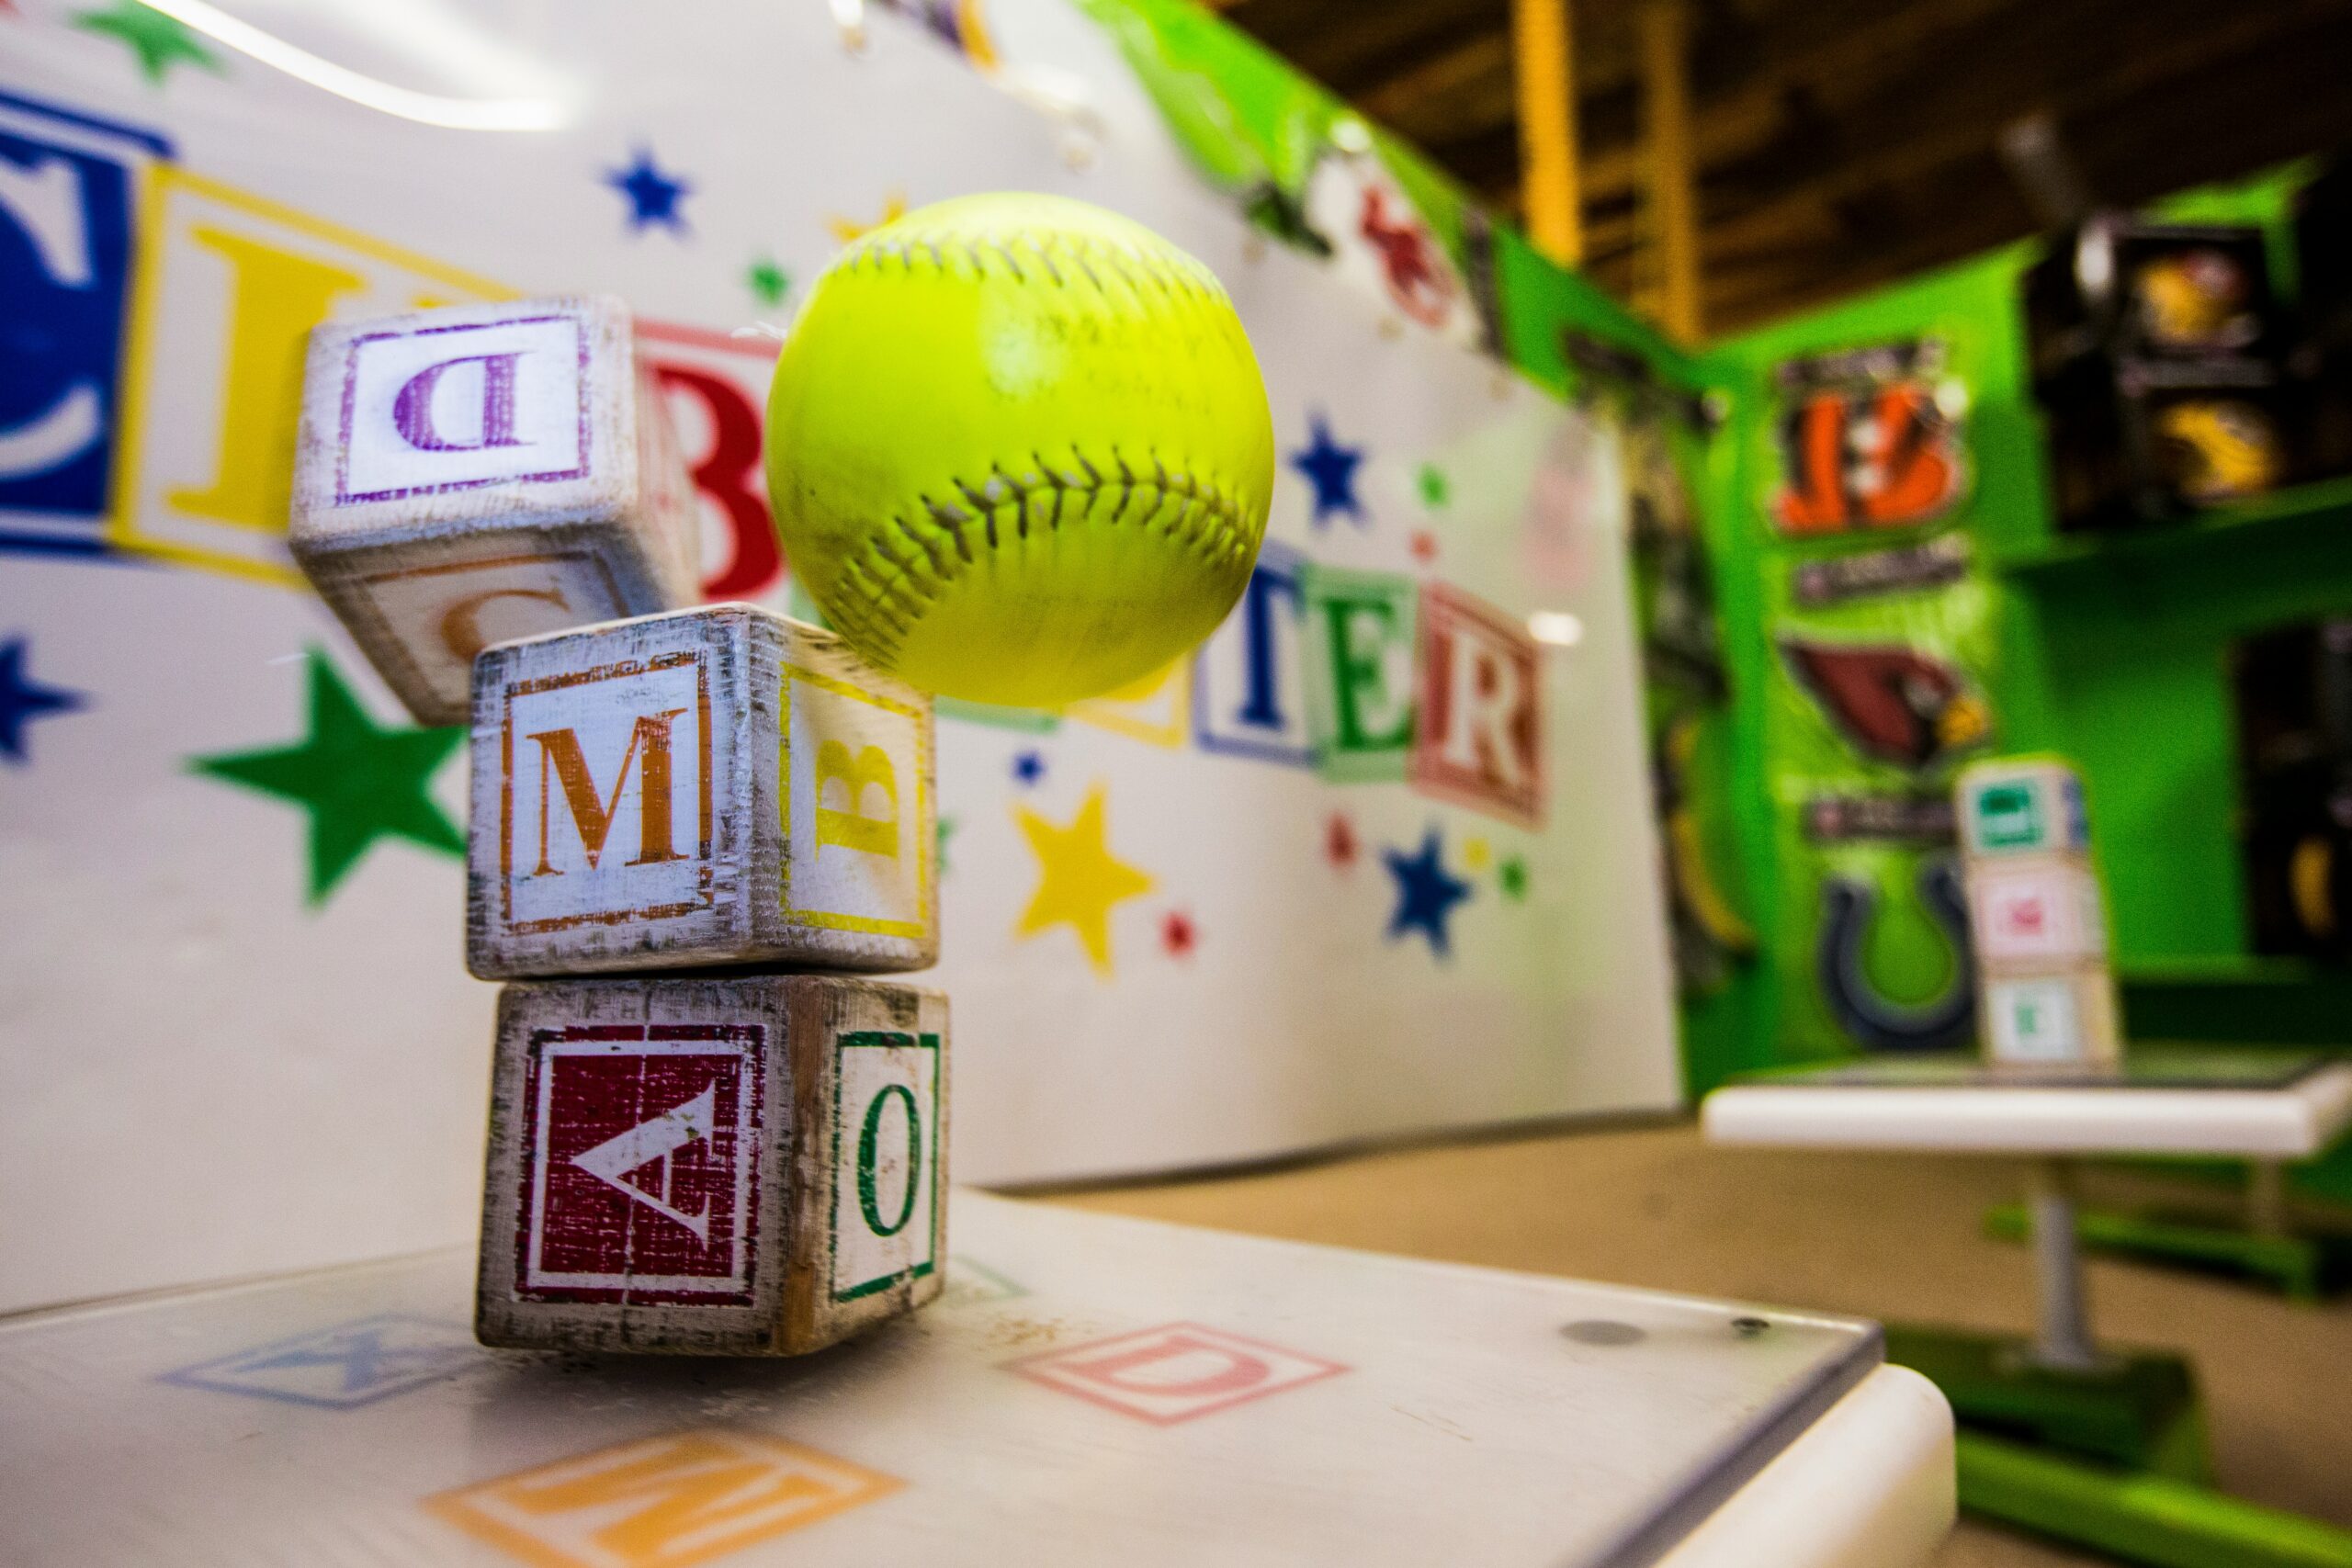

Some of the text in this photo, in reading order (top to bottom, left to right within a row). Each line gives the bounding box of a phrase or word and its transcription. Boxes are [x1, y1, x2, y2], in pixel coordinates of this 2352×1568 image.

[393, 350, 537, 452] D
[526, 707, 691, 877] M
[814, 739, 899, 863] B
[570, 1077, 717, 1251] A
[1050, 1335, 1271, 1397] D
